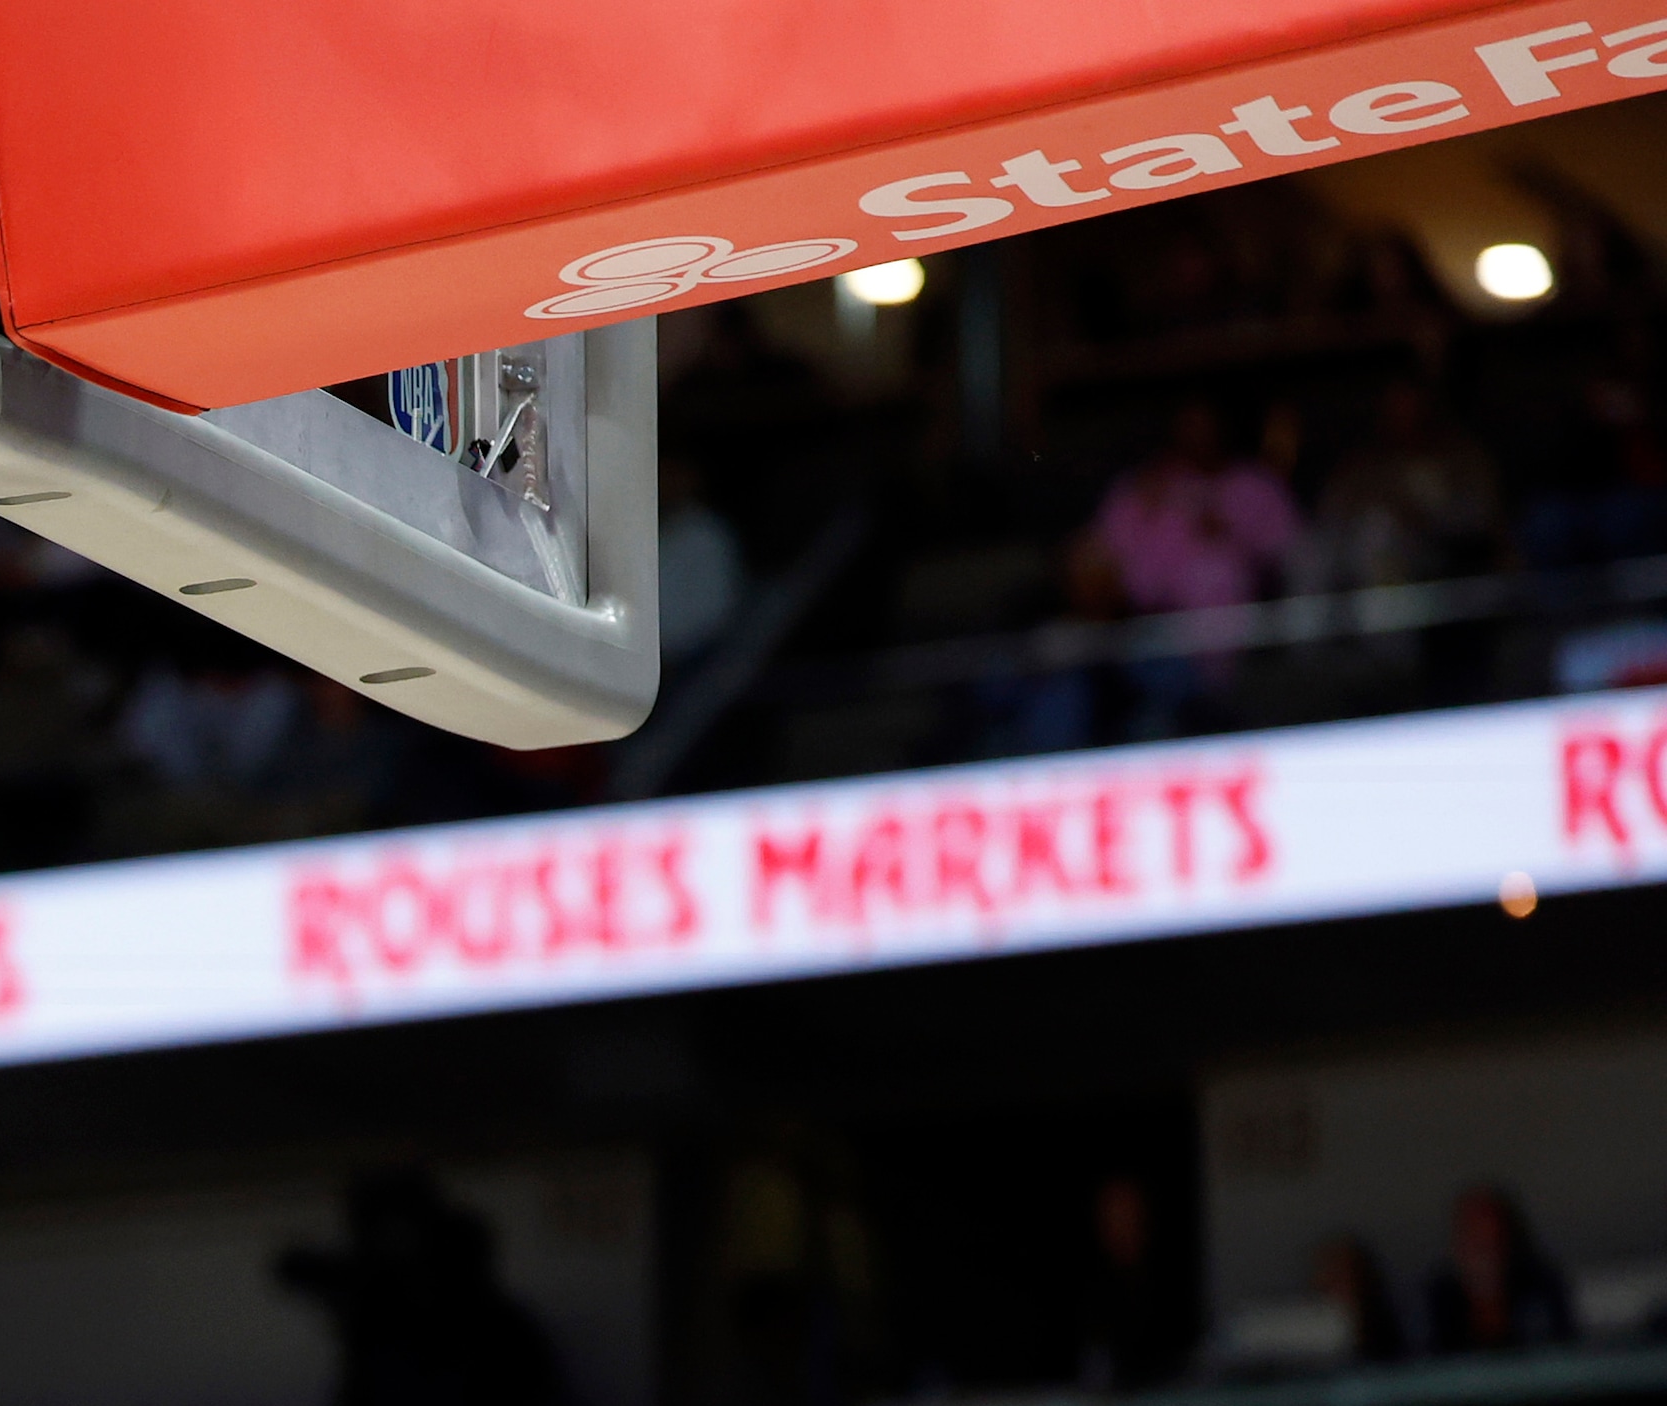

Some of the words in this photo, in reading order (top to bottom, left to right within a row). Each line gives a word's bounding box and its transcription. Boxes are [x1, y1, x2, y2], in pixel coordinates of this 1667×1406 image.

[858, 79, 1471, 242] State
[286, 828, 705, 994] ROUSES
[748, 760, 1276, 937] MARKETS
